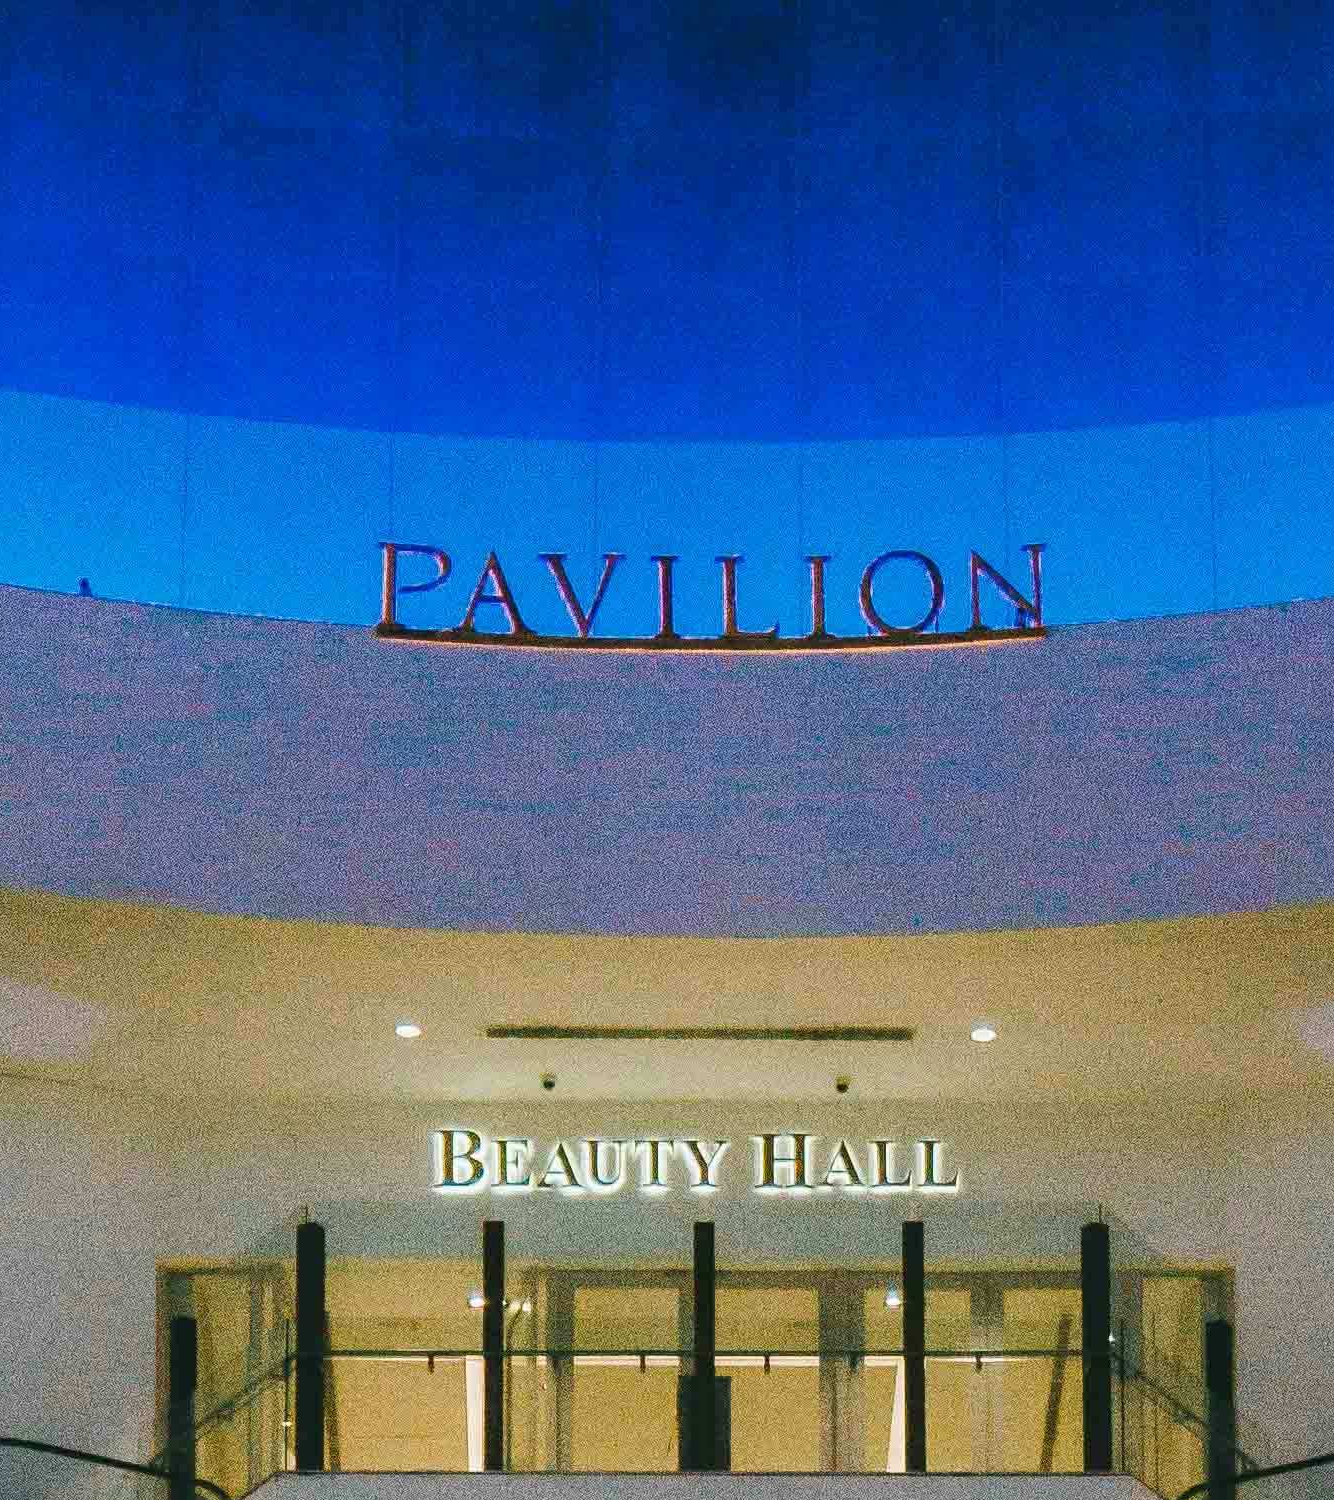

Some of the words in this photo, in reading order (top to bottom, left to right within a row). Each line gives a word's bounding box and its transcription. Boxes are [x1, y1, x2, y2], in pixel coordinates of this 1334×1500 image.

[378, 542, 1046, 636] PAVILION
[433, 1127, 728, 1191] BEAUTY
[754, 1131, 962, 1191] HALL
